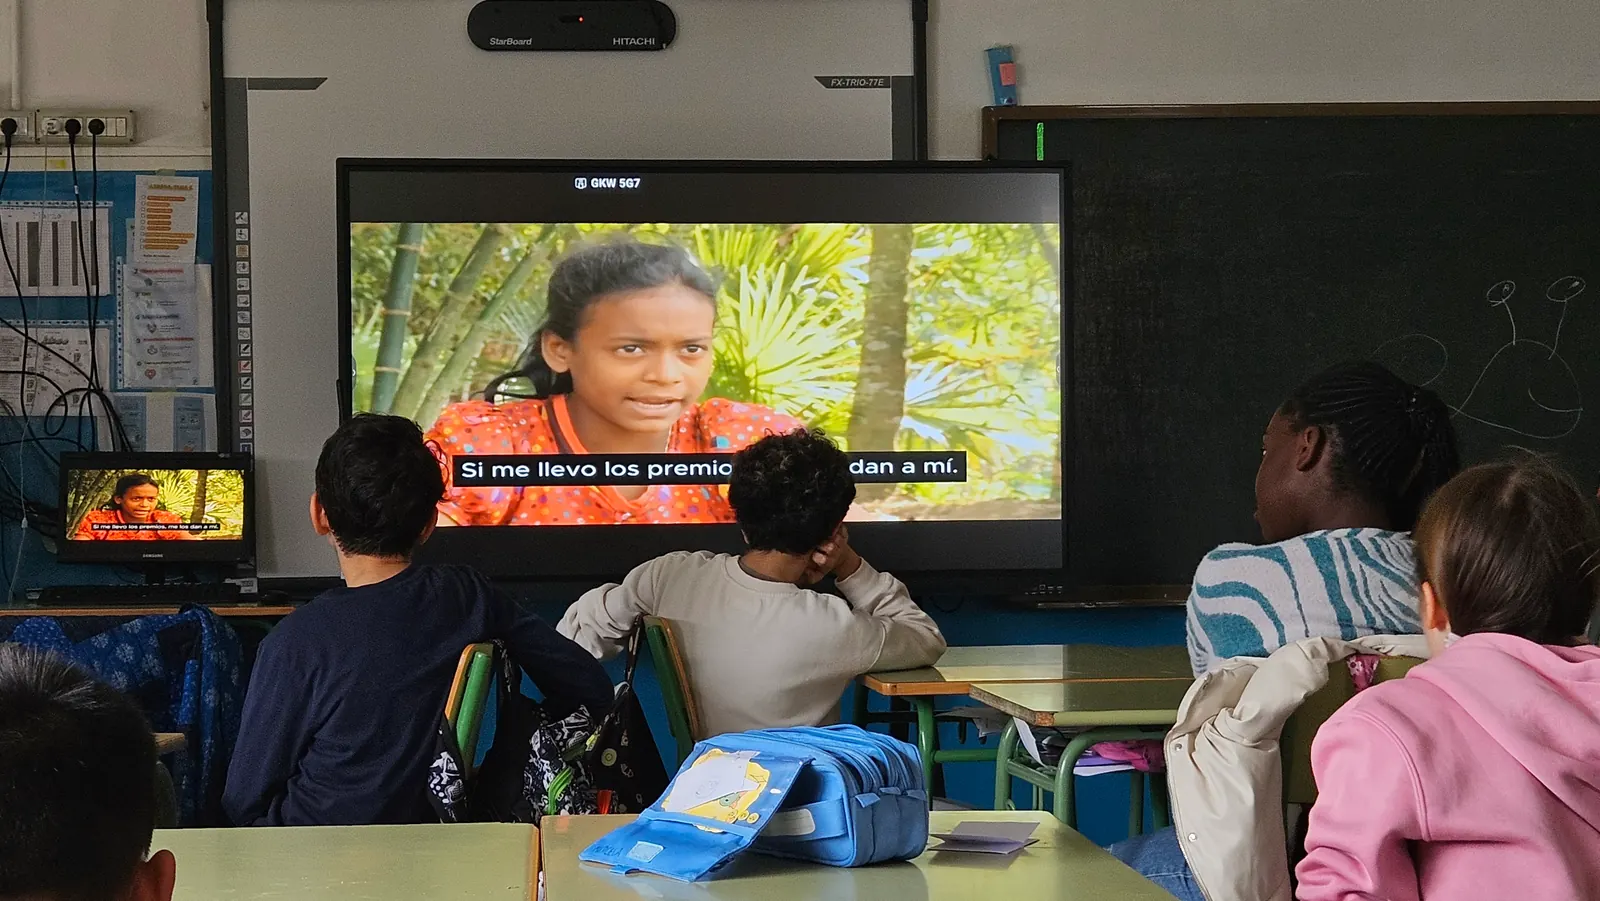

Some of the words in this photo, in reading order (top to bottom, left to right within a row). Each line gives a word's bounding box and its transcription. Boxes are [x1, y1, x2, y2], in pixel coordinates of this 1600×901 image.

[489, 37, 533, 46] StarBoard
[612, 37, 656, 46] HITACHI
[830, 78, 885, 87] FX-TRIO-77E
[590, 177, 617, 189] GKW
[618, 177, 641, 189] 5G7
[461, 461, 483, 478] Si
[491, 464, 530, 478] me
[538, 461, 597, 478] llevo
[604, 460, 640, 477] los
[647, 459, 733, 480] premio
[849, 458, 894, 475] dan
[901, 462, 916, 475] a
[923, 457, 959, 475] mí.
